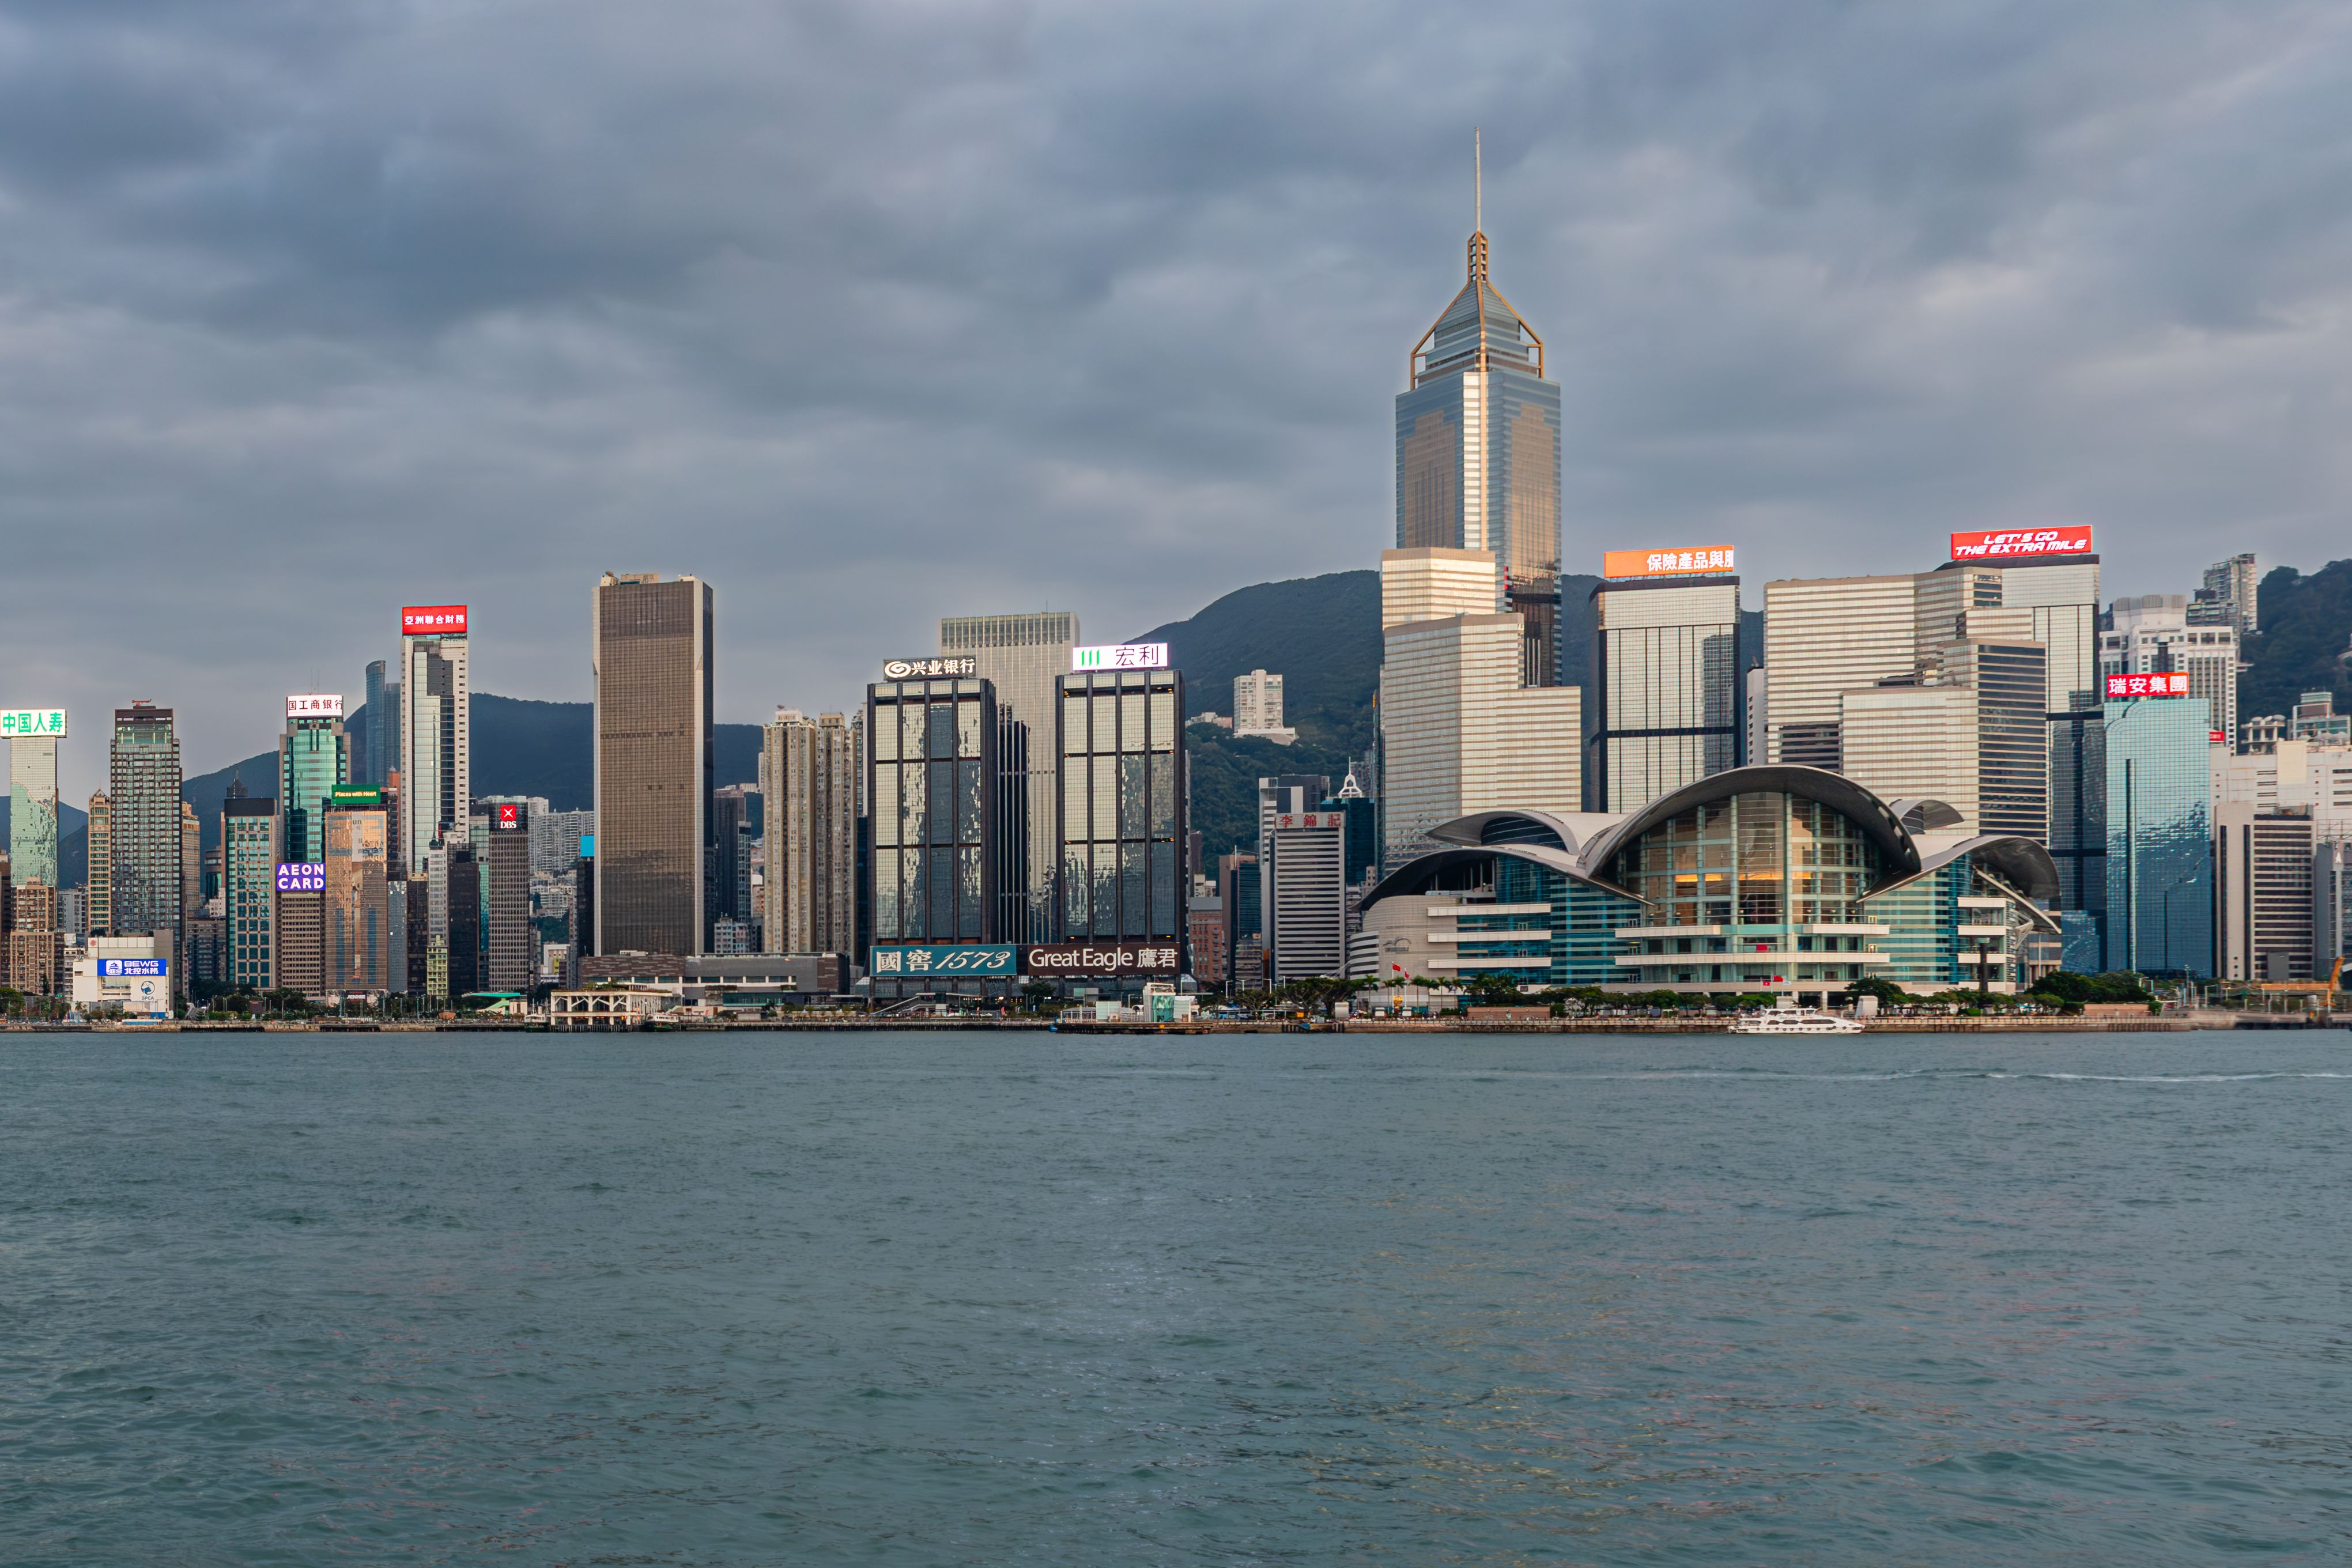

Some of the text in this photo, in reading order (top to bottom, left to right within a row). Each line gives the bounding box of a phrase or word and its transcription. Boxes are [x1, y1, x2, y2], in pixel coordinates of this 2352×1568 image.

[1984, 531, 2058, 545] LET'S GO
[1955, 539, 2087, 556] THE EXTRA MILE
[405, 614, 465, 625] 亞洲聯合財務
[1116, 645, 1158, 666] 宏利
[911, 659, 975, 676] 兴业银行
[2109, 675, 2187, 694] 瑞安集團
[3, 712, 63, 734] 中国人寿
[1278, 814, 1342, 828] 李錦記
[278, 864, 324, 875] AEON
[278, 878, 324, 889] CARD
[876, 949, 1011, 973] 國窖 1573
[1029, 947, 1177, 972] Great Eagle 鷹君
